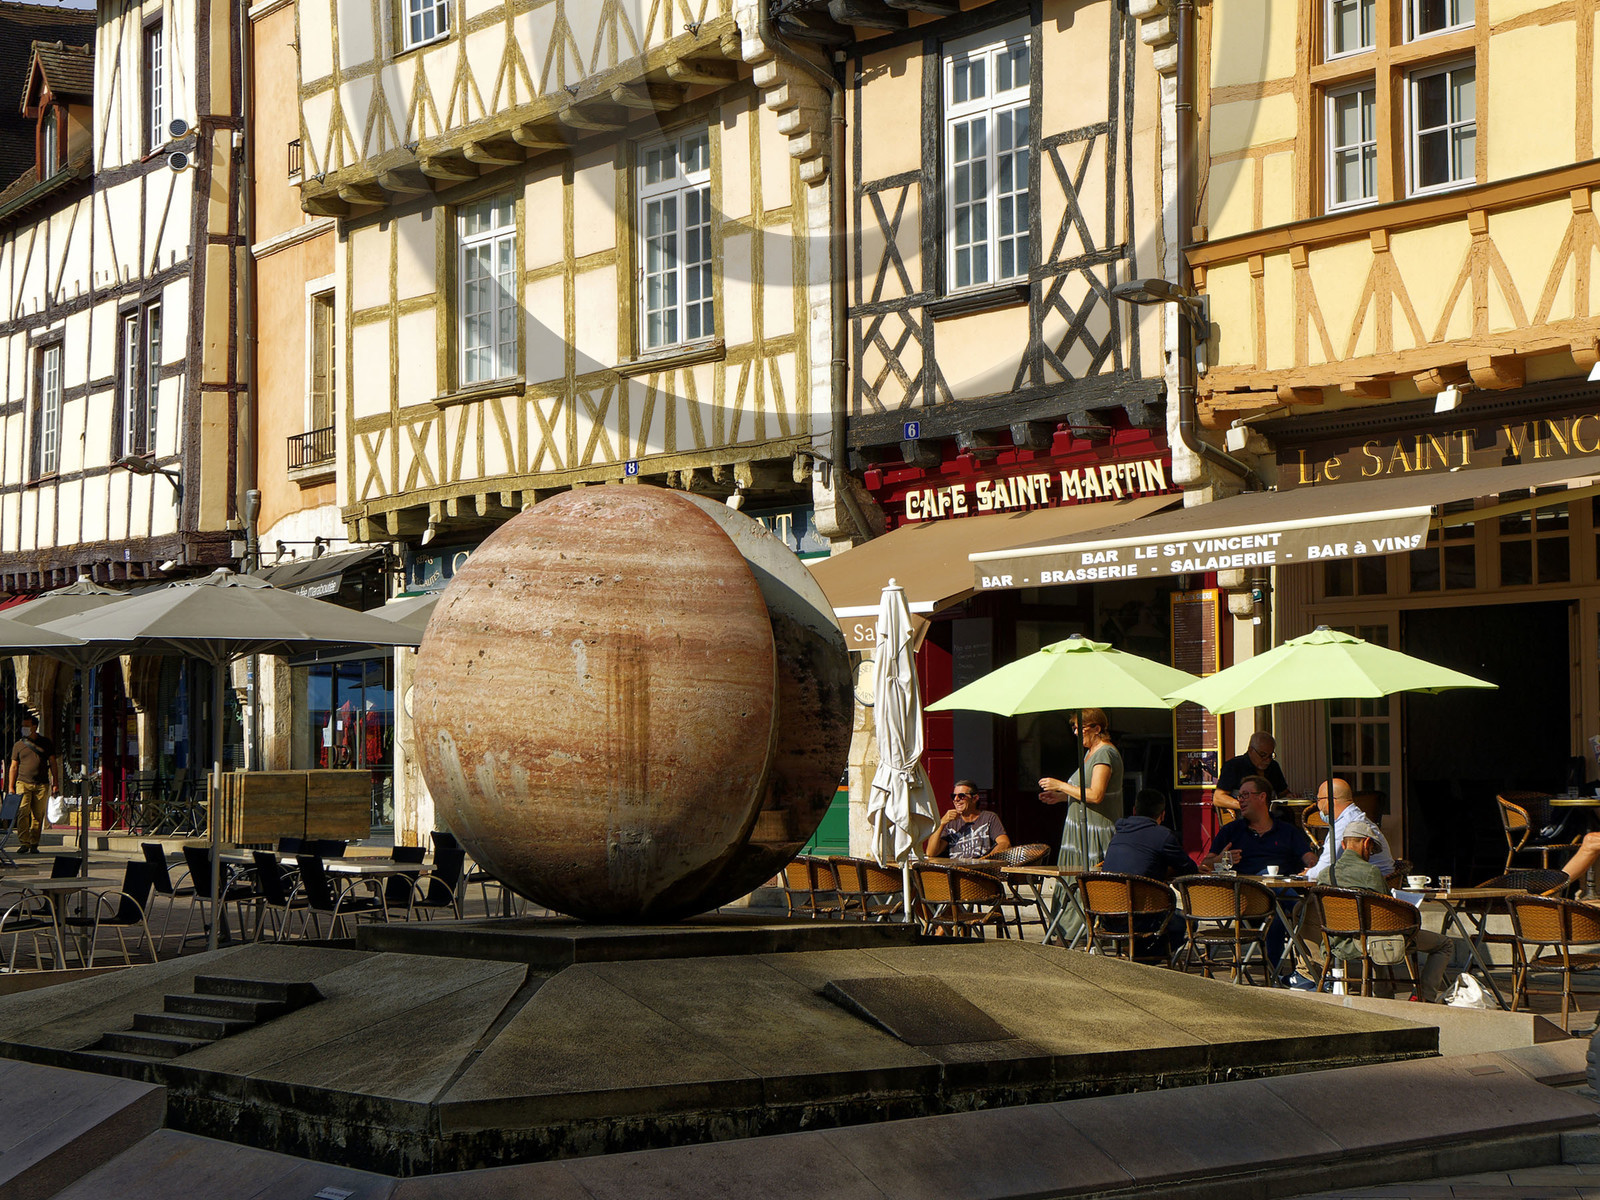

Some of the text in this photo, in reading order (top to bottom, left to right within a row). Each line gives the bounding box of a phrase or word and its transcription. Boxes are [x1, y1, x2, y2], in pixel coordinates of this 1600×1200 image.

[907, 423, 916, 437] 6
[627, 462, 636, 474] 8
[1298, 448, 1341, 484] Le
[1361, 428, 1478, 477] SAINT
[975, 473, 1051, 511] SAINT
[1059, 459, 1168, 500] MARTIN
[981, 575, 1013, 588] BAR
[1040, 564, 1138, 584] BRASSERIE
[1170, 551, 1276, 573] SALADERIE
[1307, 543, 1348, 559] BAR
[1353, 541, 1367, 555] à
[1371, 534, 1422, 553] VINS
[1081, 533, 1282, 566] BAR LE ST VINCENT
